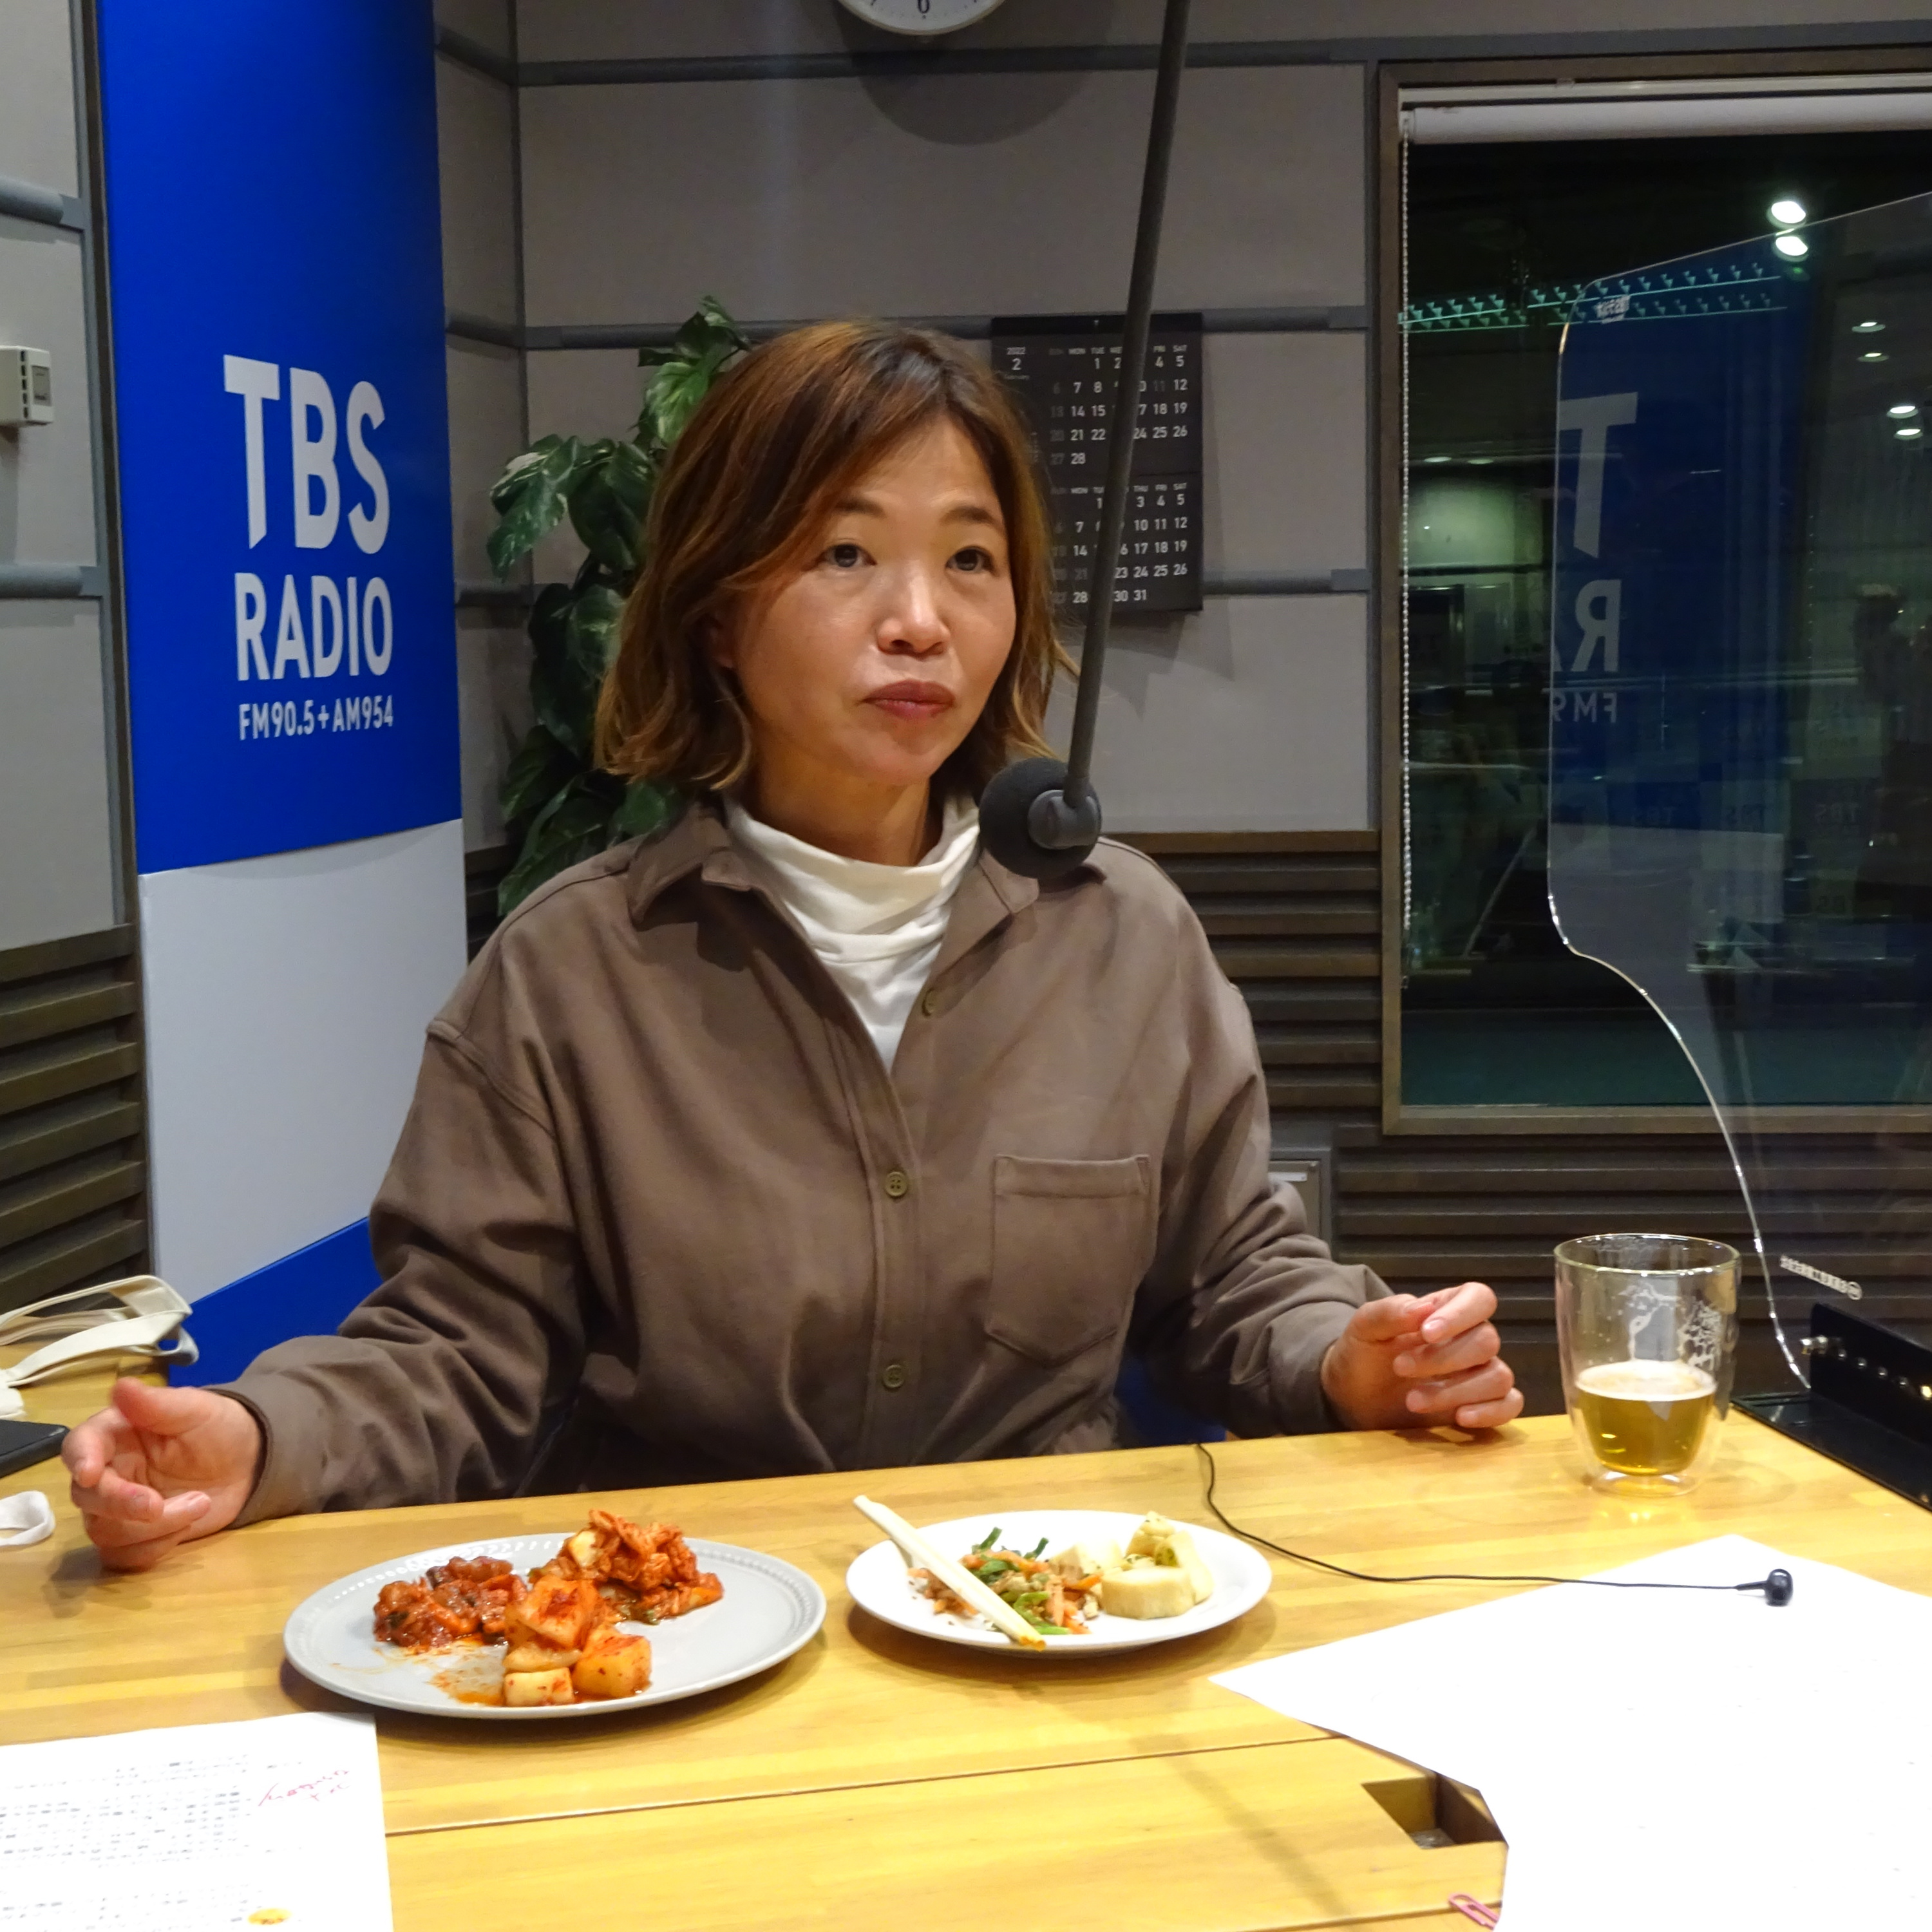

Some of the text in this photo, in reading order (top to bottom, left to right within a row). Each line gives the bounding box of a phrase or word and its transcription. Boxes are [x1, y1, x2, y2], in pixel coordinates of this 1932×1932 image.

[1012, 358, 1021, 371] 2
[1095, 355, 1184, 369] 1 2 4 5
[1074, 382, 1081, 393] 7
[1094, 381, 1103, 393] 8
[1174, 379, 1188, 390] 12
[1072, 406, 1085, 417] 14
[1092, 405, 1106, 417] 15
[1153, 403, 1167, 415] 18
[1173, 402, 1188, 413] 19
[1070, 430, 1083, 440] 21
[1091, 429, 1106, 440] 22
[1133, 428, 1146, 439] 24
[1153, 426, 1167, 438] 25
[1173, 426, 1188, 437] 26
[223, 354, 389, 554] TBS
[1070, 452, 1086, 464] 28
[1097, 494, 1184, 509] 1 3 4 5
[1075, 522, 1084, 533] 7
[1134, 520, 1148, 531] 10
[1155, 519, 1167, 529] 11
[1174, 517, 1188, 528] 12
[1074, 545, 1088, 556] 14
[1134, 543, 1148, 554] 17
[1155, 542, 1168, 553] 18
[1174, 541, 1187, 551] 19
[1115, 567, 1128, 578] 23
[1133, 567, 1148, 577] 24
[1154, 565, 1168, 576] 25
[1173, 564, 1187, 575] 26
[1073, 592, 1088, 603] 28
[1113, 591, 1128, 601] 30
[1133, 590, 1146, 600] 31
[234, 572, 393, 681] RADIO
[239, 695, 393, 740] FM90.5+AM954
